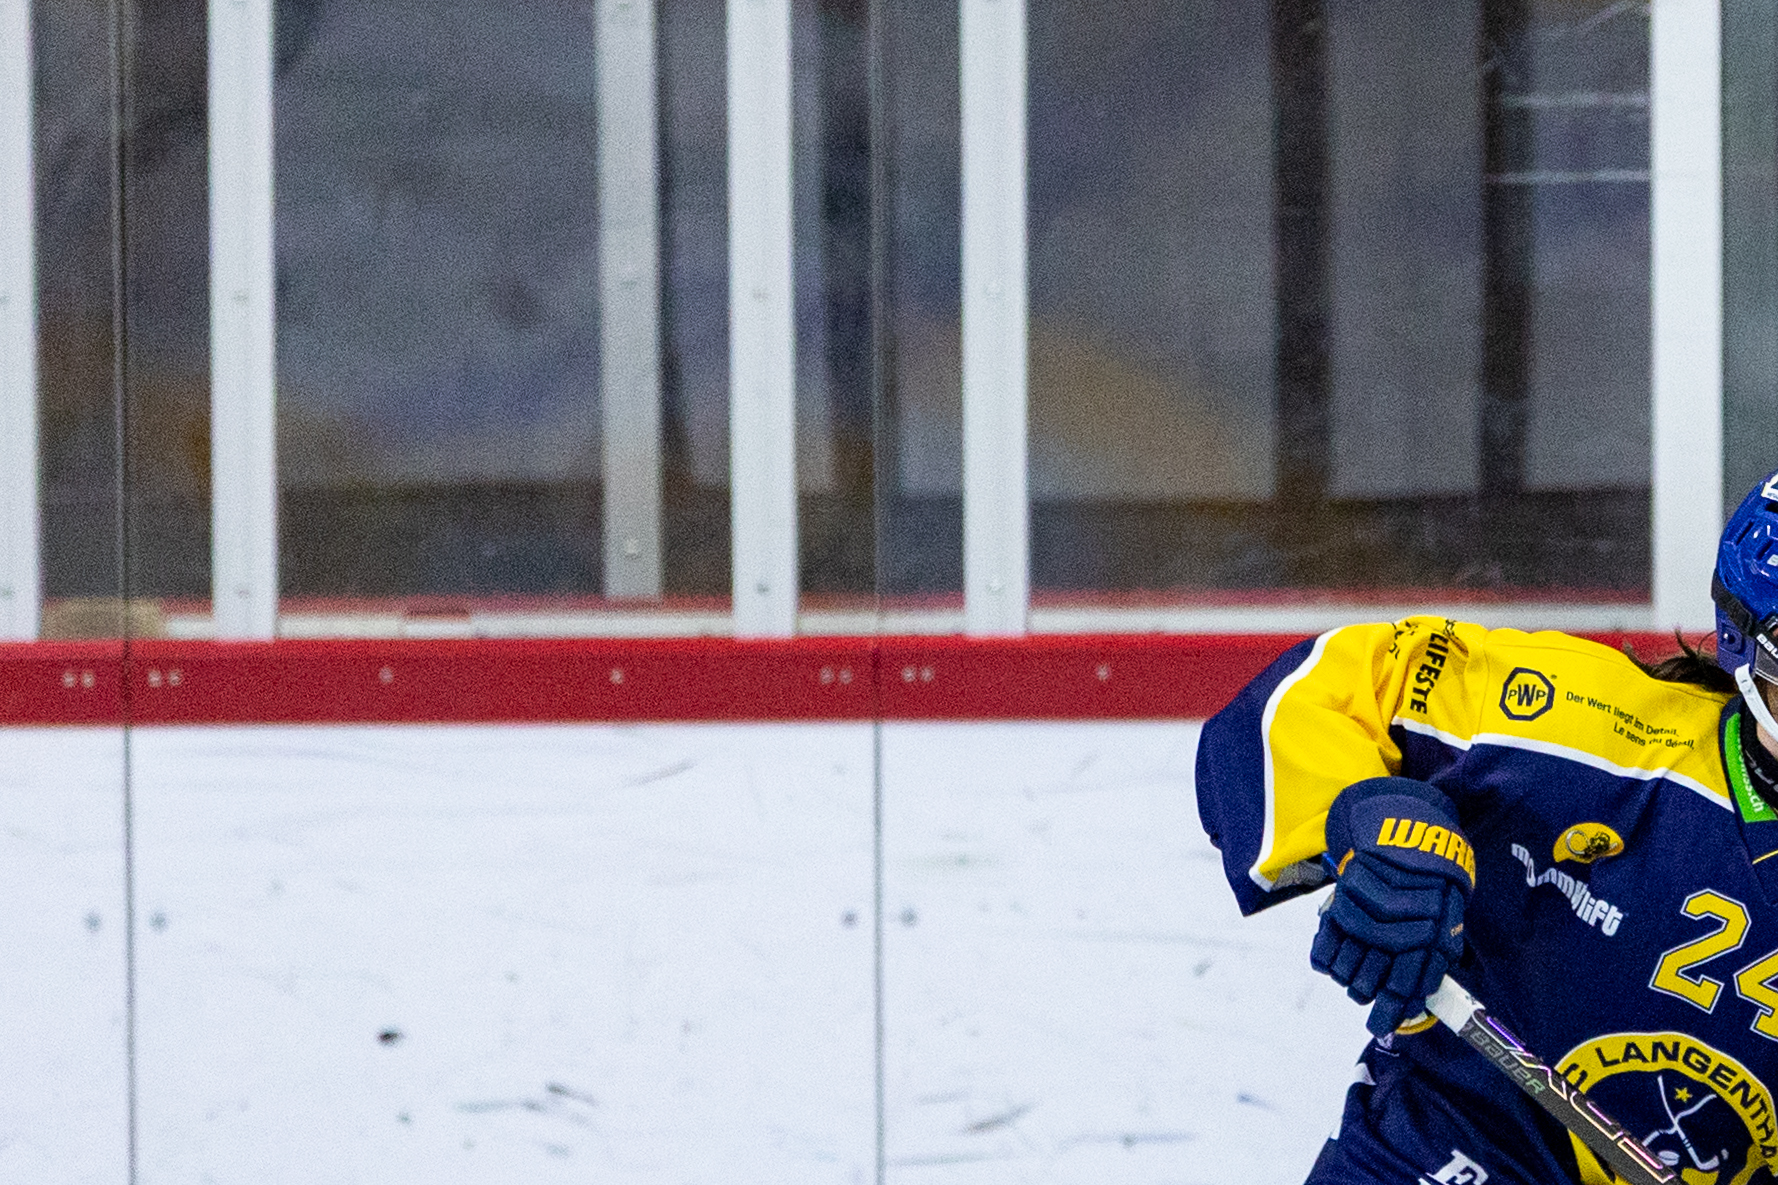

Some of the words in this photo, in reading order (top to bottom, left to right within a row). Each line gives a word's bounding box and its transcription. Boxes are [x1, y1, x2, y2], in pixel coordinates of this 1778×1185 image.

[1566, 691, 1584, 703] Der
[1587, 697, 1611, 713] Wert
[1613, 707, 1634, 724] liegt
[1634, 718, 1644, 730] im
[1614, 722, 1624, 735] Le
[1626, 730, 1646, 747] sens
